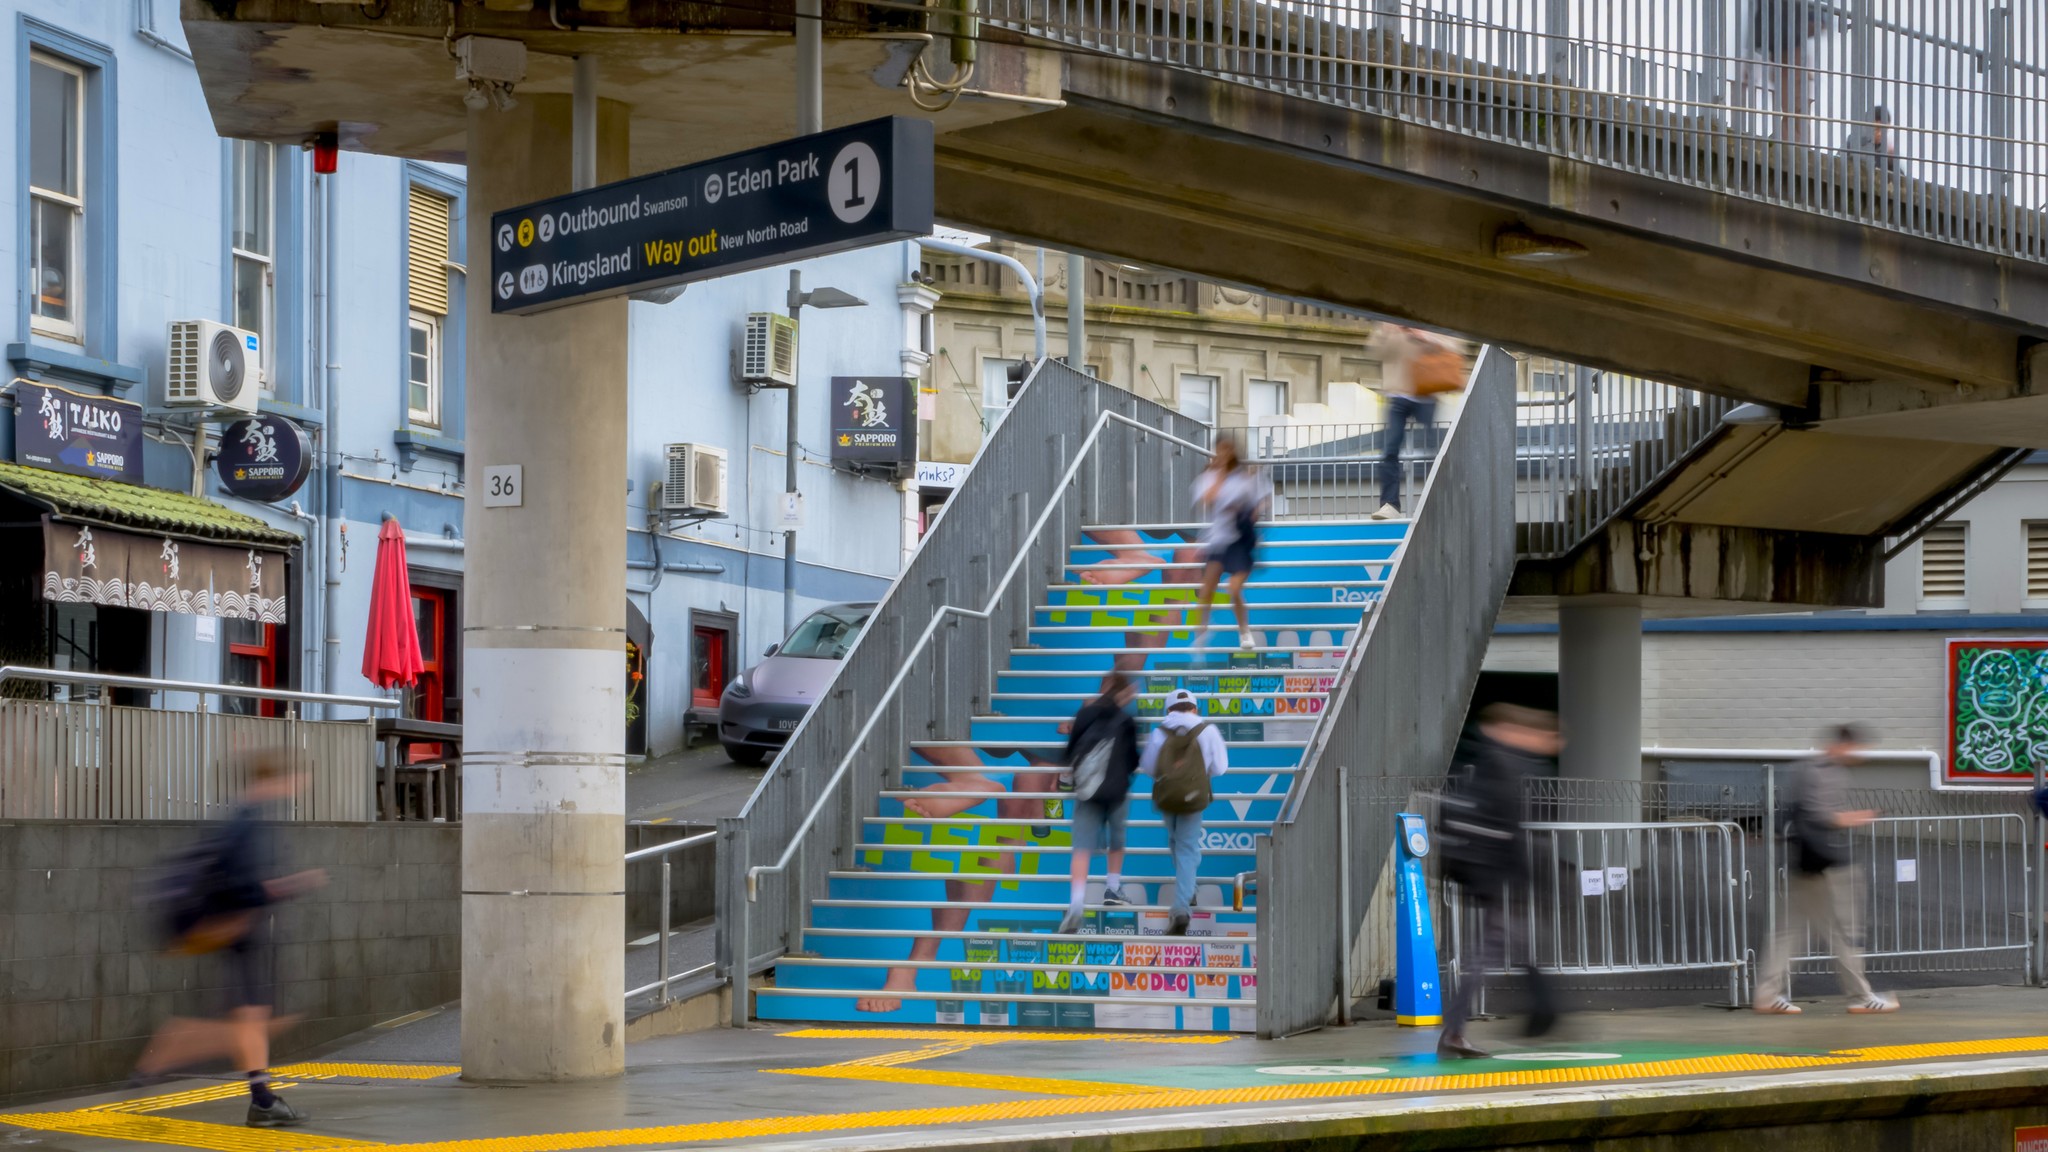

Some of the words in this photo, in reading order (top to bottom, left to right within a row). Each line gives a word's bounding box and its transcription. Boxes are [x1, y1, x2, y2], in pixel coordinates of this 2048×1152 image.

[727, 168, 773, 198] Eden
[777, 152, 819, 188] Park
[843, 157, 866, 209] 1
[542, 220, 551, 238] 2
[559, 195, 640, 237] Outbound
[644, 195, 688, 216] Swanson
[645, 239, 684, 267] Way
[688, 229, 718, 262] out
[720, 234, 744, 250] New
[746, 226, 778, 244] North
[780, 217, 808, 236] Road
[552, 247, 631, 287] Kingsland
[70, 403, 121, 432] TAIKO
[854, 433, 896, 443] SAPPORO
[97, 451, 124, 467] SAPPORO
[248, 467, 284, 476] SAPPORO
[491, 475, 514, 497] 36
[1198, 827, 1256, 849] Rexo
